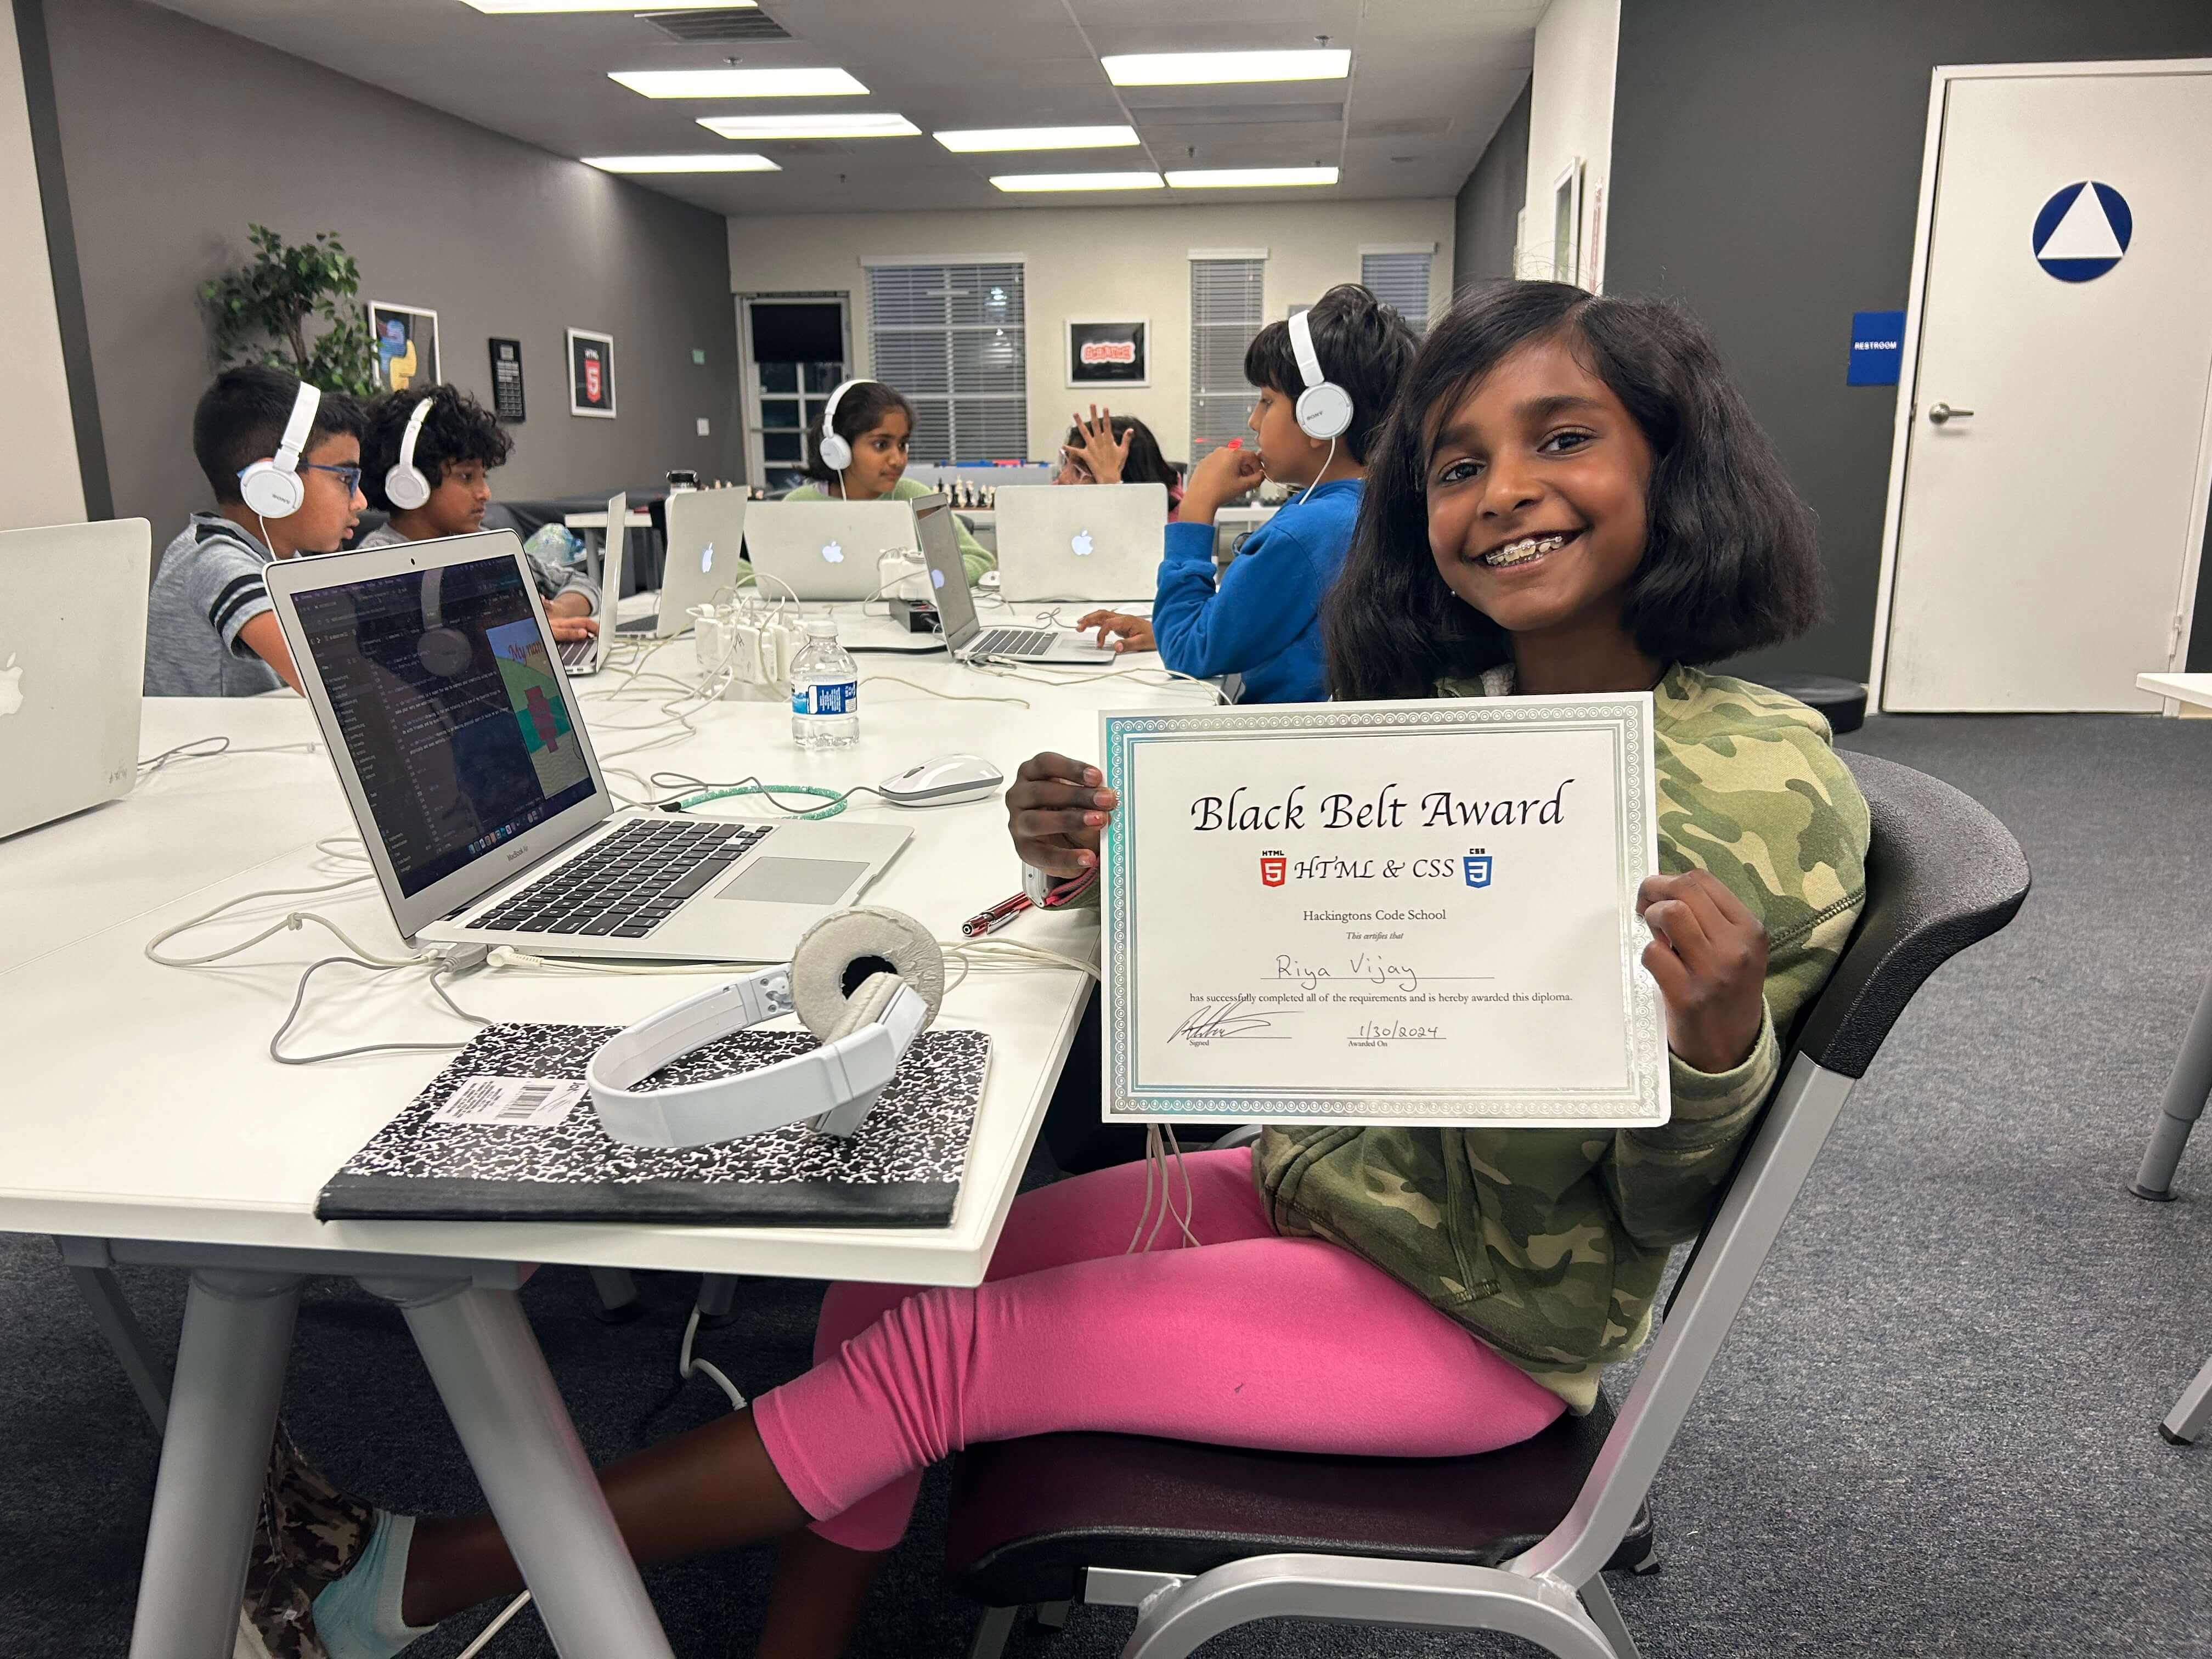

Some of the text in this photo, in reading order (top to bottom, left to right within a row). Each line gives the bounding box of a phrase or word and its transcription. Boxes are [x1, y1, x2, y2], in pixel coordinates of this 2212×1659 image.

[1854, 341, 1897, 351] RESTROOM
[1190, 778, 1576, 831] Black Belt Award
[1264, 862, 1283, 882] 5
[1294, 855, 1454, 879] HTML & CSS
[1468, 861, 1487, 883] 3
[1303, 909, 1446, 924] Hackingtons Code School
[1346, 931, 1404, 942] This certifies that
[1276, 952, 1417, 992] Riya Vijay
[1190, 992, 1573, 1005] has successfully completed all of the requirements and is hereby awarded this diploma.
[1359, 1019, 1439, 1040] 1/30/2024
[1189, 1039, 1210, 1047] Signed
